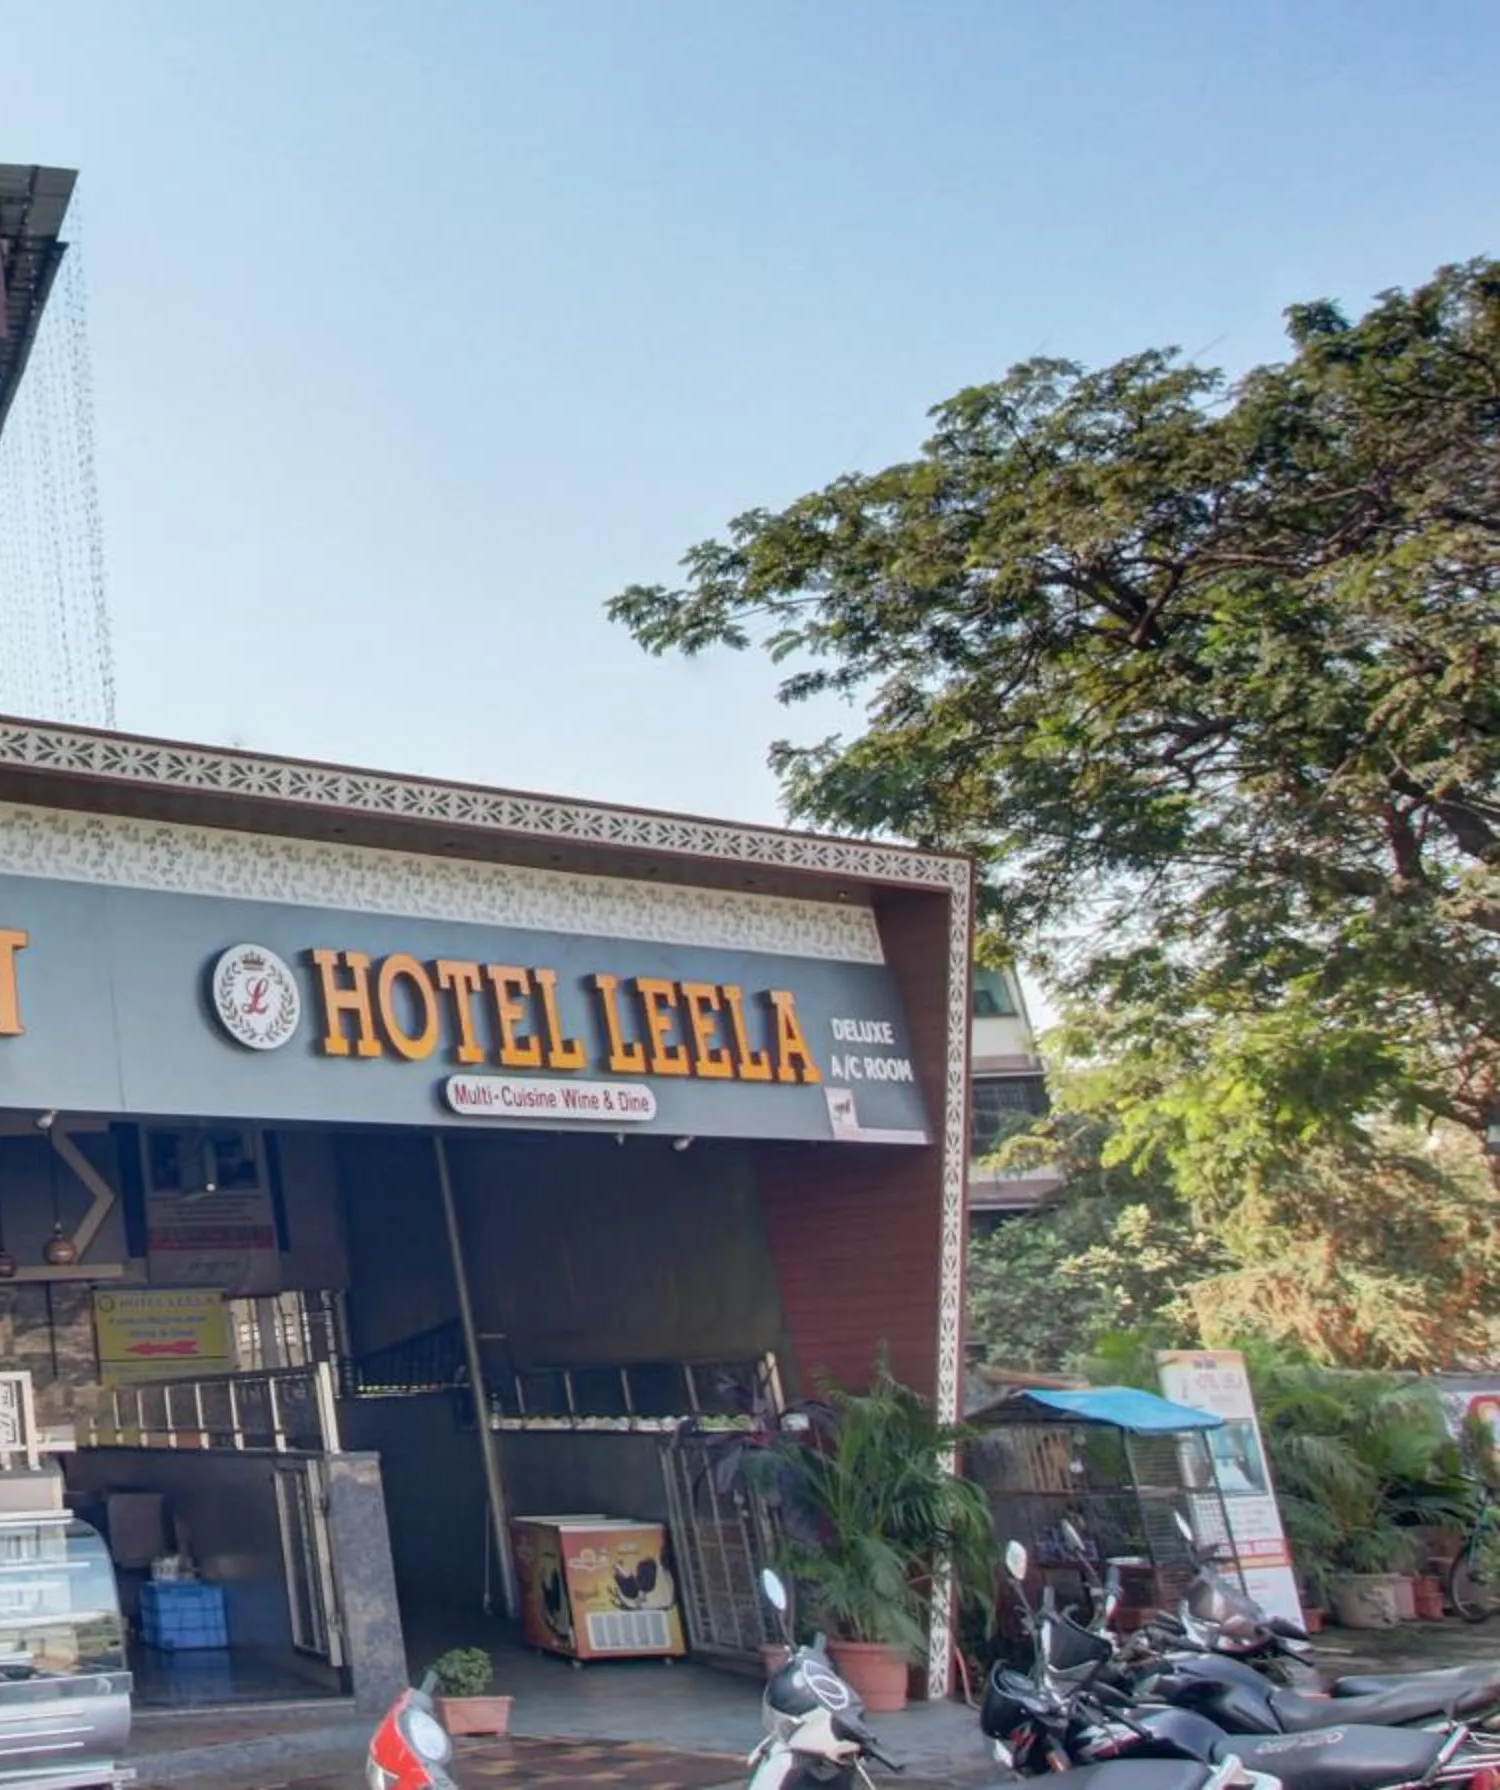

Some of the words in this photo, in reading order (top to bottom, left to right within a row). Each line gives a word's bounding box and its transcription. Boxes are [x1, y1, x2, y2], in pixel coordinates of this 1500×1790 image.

[312, 948, 587, 1070] HOTEL
[595, 973, 822, 1084] LEELA
[831, 1017, 895, 1045] DELUXE
[831, 1054, 862, 1081] A/C
[863, 1056, 914, 1082] ROOM
[453, 1083, 558, 1109] Multi-Cuisine
[560, 1087, 600, 1110] Wine
[603, 1090, 614, 1110] &
[617, 1091, 650, 1113] Dine
